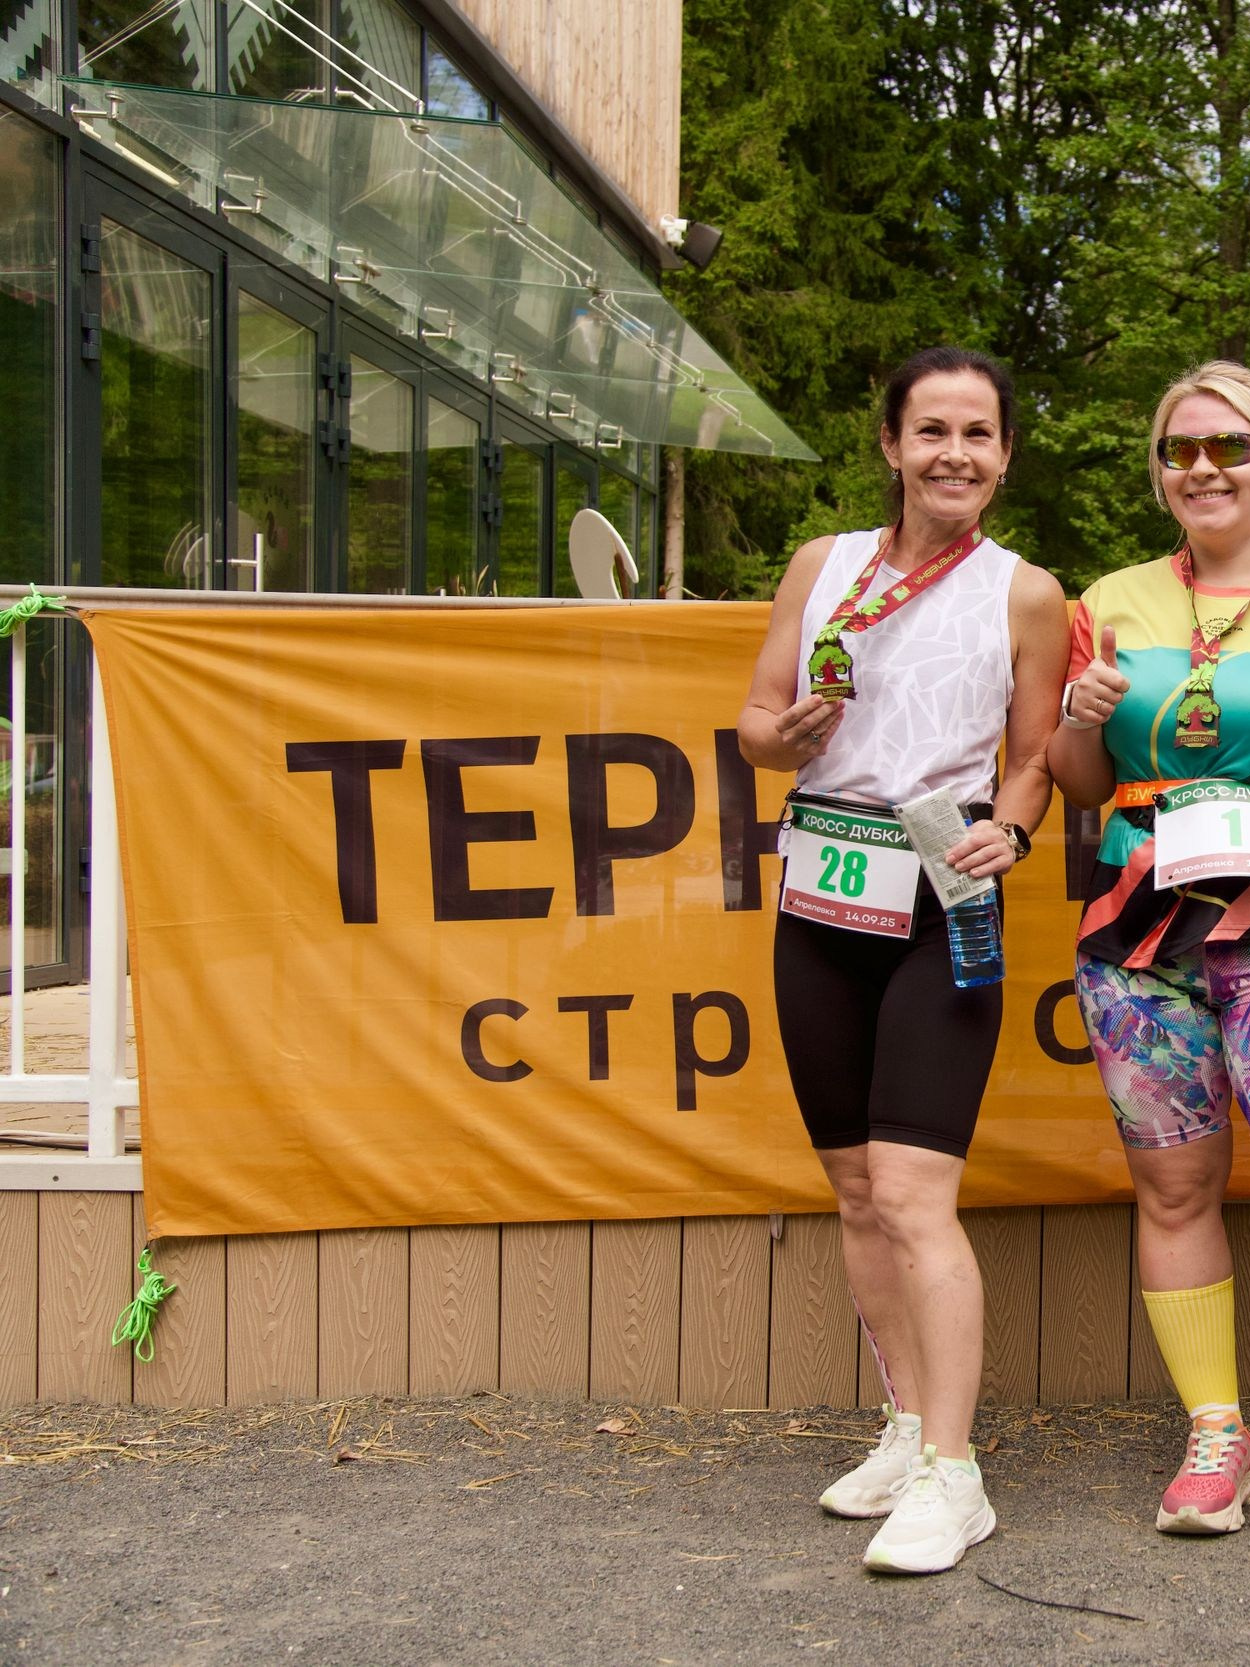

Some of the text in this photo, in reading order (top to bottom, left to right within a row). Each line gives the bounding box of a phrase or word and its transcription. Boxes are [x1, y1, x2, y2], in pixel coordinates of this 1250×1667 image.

[1171, 785, 1231, 807] КРОСС
[802, 813, 908, 844] КРОСС ДУБКИ
[1220, 808, 1243, 847] 1
[817, 845, 869, 898] 28
[1172, 858, 1235, 876] Апрелевка
[793, 898, 897, 928] Апрелевка 14.09.25
